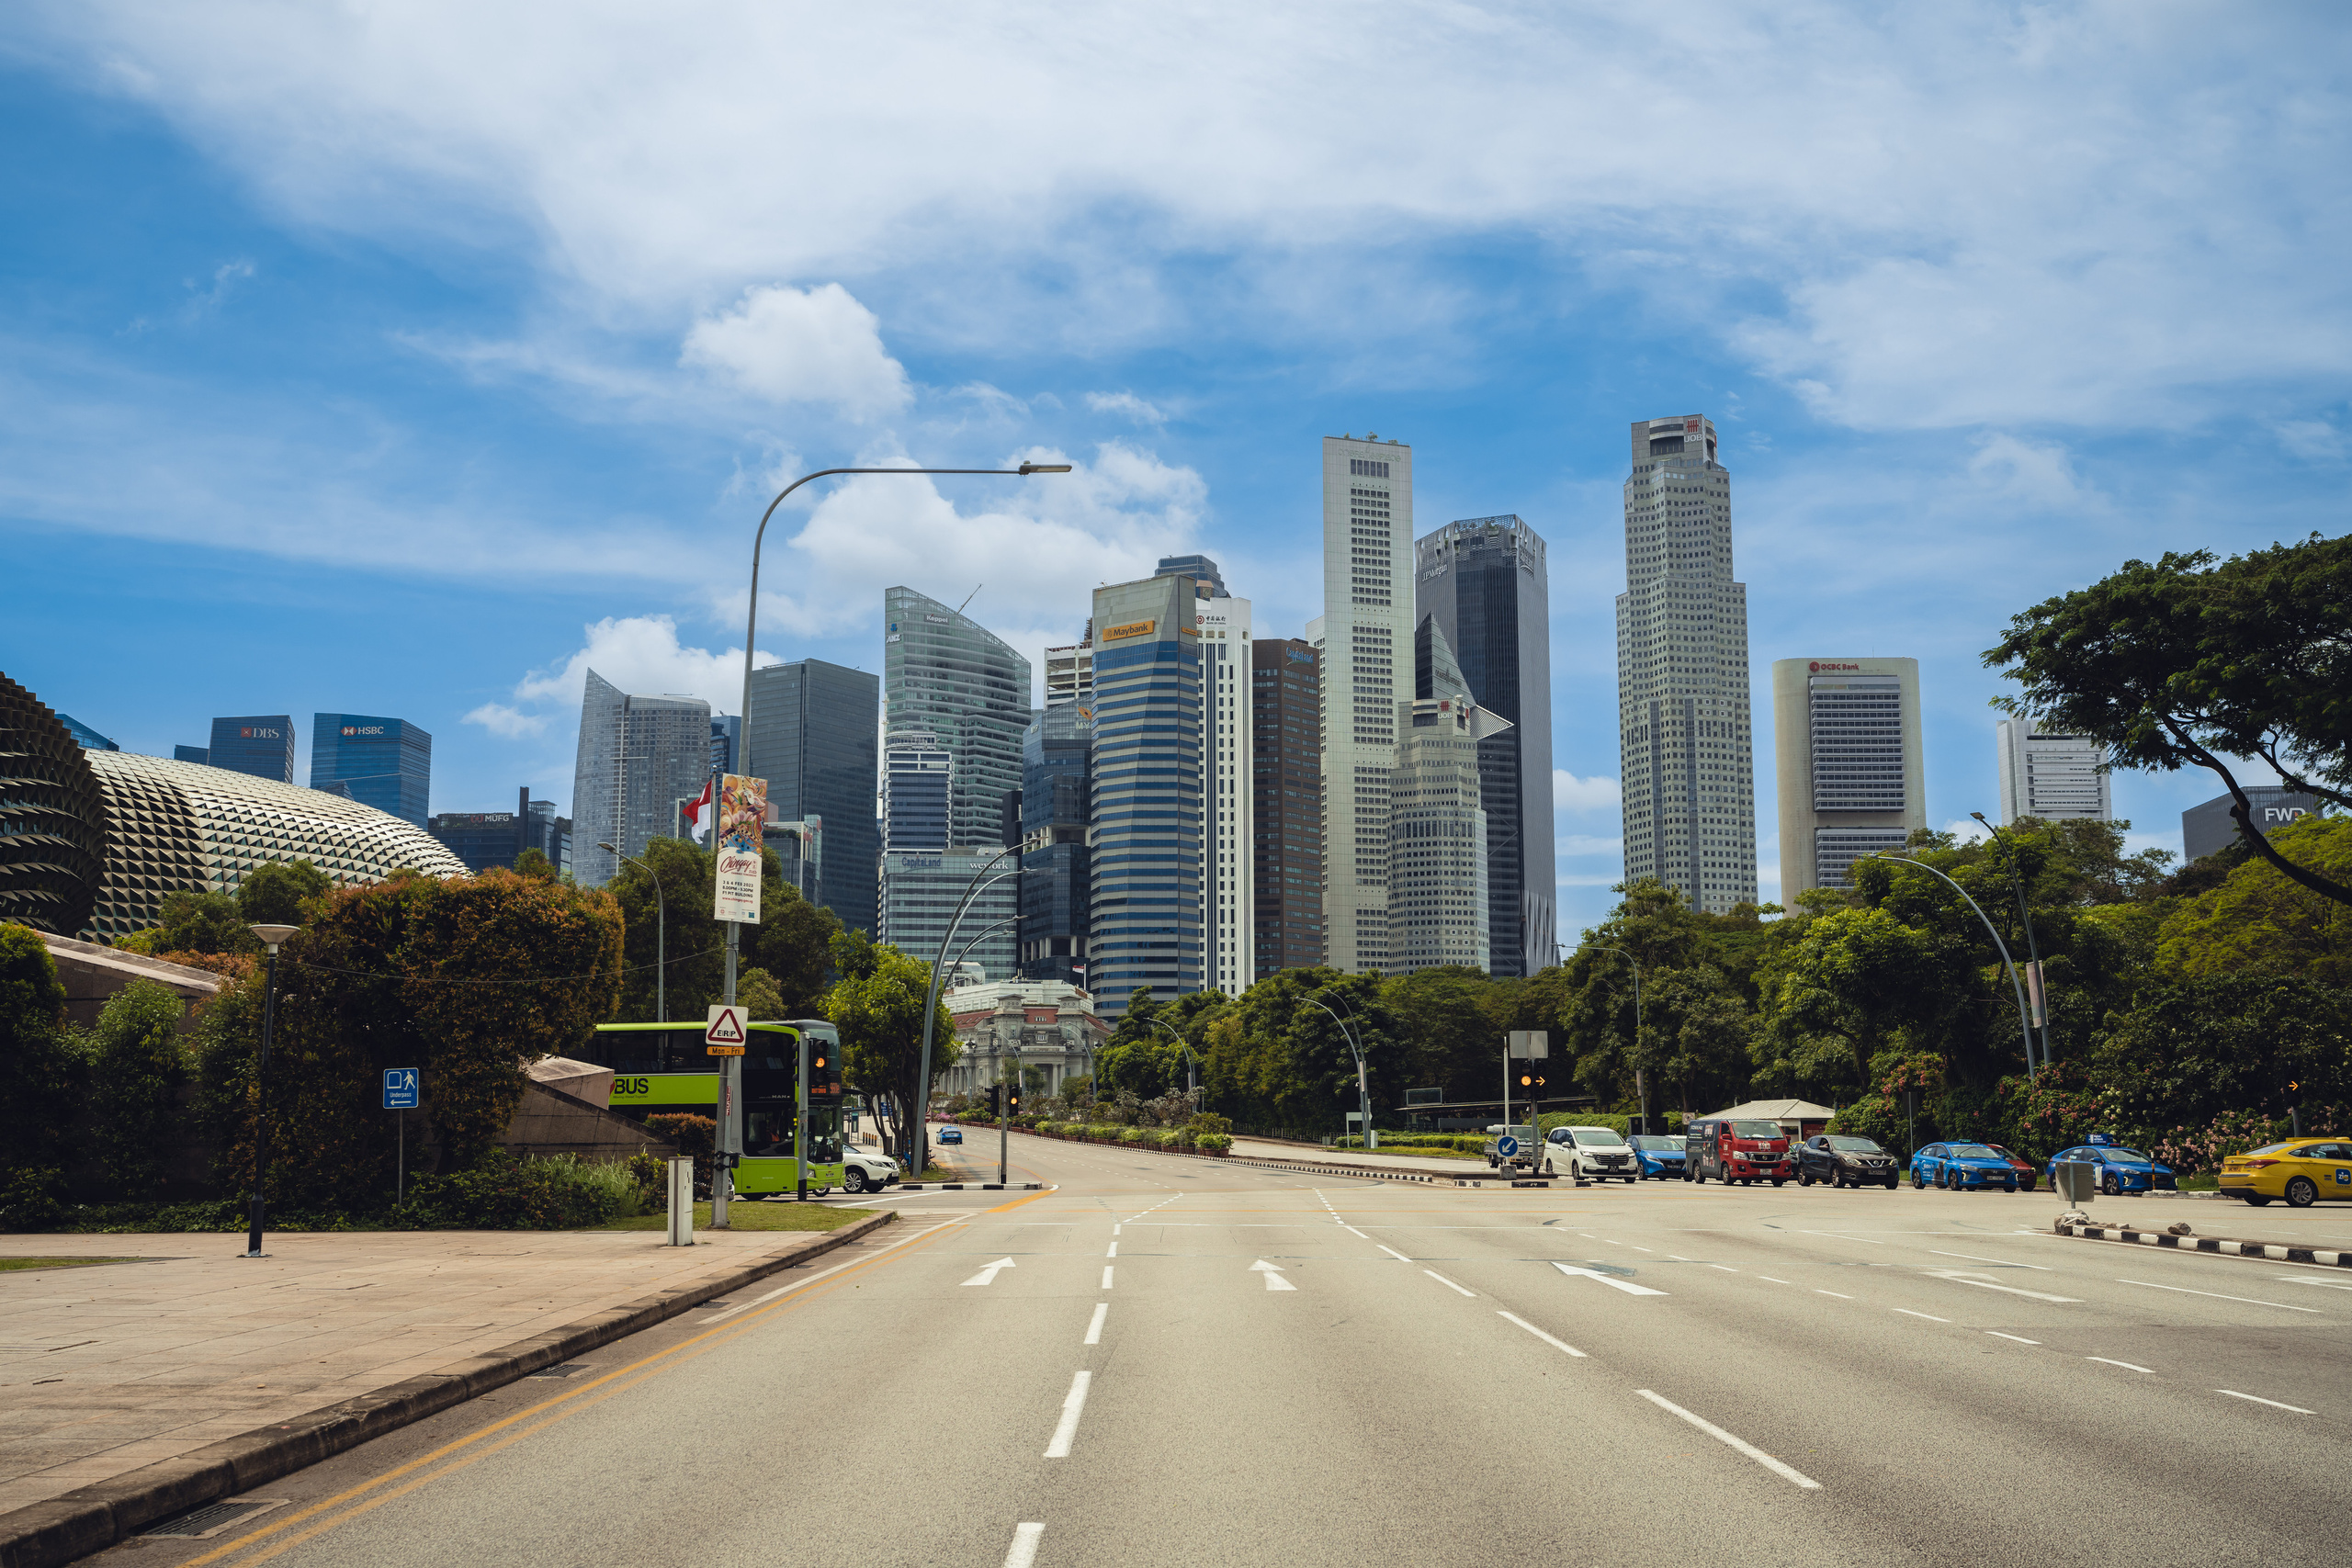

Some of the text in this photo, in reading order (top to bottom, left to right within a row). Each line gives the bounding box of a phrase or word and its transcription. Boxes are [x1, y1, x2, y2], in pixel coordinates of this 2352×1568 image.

[1683, 434, 1702, 443] UOB
[926, 614, 948, 623] Keppel
[1113, 624, 1148, 637] Maybank
[887, 634, 901, 643] ANZ
[1286, 647, 1313, 663] CapitaLand
[254, 728, 279, 739] DBS
[357, 726, 384, 735] HSBC
[720, 856, 752, 873] Chingay
[901, 855, 942, 869] CapitaLand
[614, 1078, 649, 1094] BUS
